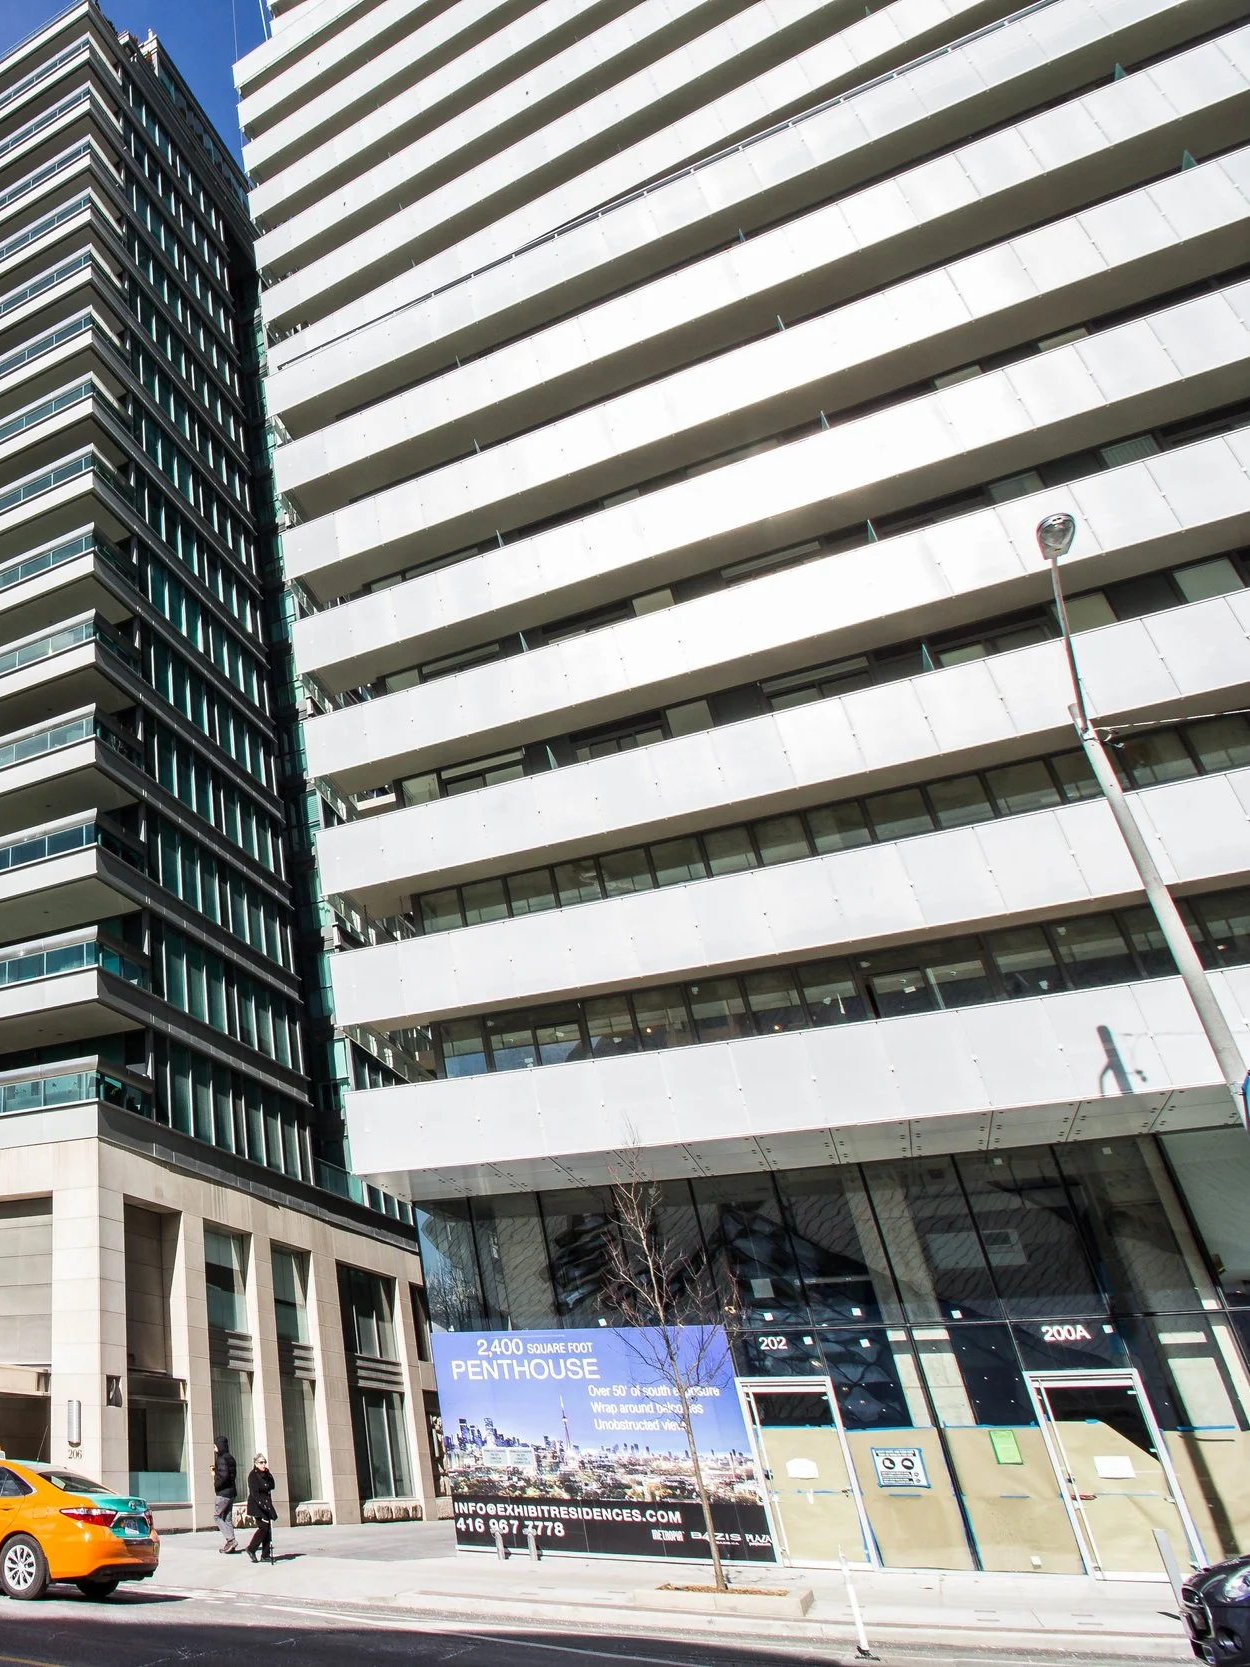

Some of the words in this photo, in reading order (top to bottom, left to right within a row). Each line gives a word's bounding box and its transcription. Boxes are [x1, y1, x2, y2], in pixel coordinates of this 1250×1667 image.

[1040, 1324, 1092, 1342] 200A
[477, 1338, 523, 1357] 2,400
[527, 1343, 566, 1354] SQUARE
[568, 1342, 593, 1353] FOOT
[758, 1336, 788, 1350] 202
[451, 1358, 601, 1380] PENTHOUSE
[588, 1385, 610, 1397] Over
[630, 1385, 640, 1397] of
[642, 1385, 671, 1397] south
[672, 1386, 720, 1399] eposure
[590, 1401, 616, 1415] Wrap
[619, 1402, 654, 1414] around
[594, 1418, 660, 1431] Unobstructed
[68, 1449, 83, 1460] 206
[454, 1502, 682, 1524] INFO@EXHIBITRESIDENCES.COM
[456, 1517, 485, 1533] 416
[489, 1518, 519, 1535] 967
[745, 1533, 772, 1544] PLAZA
